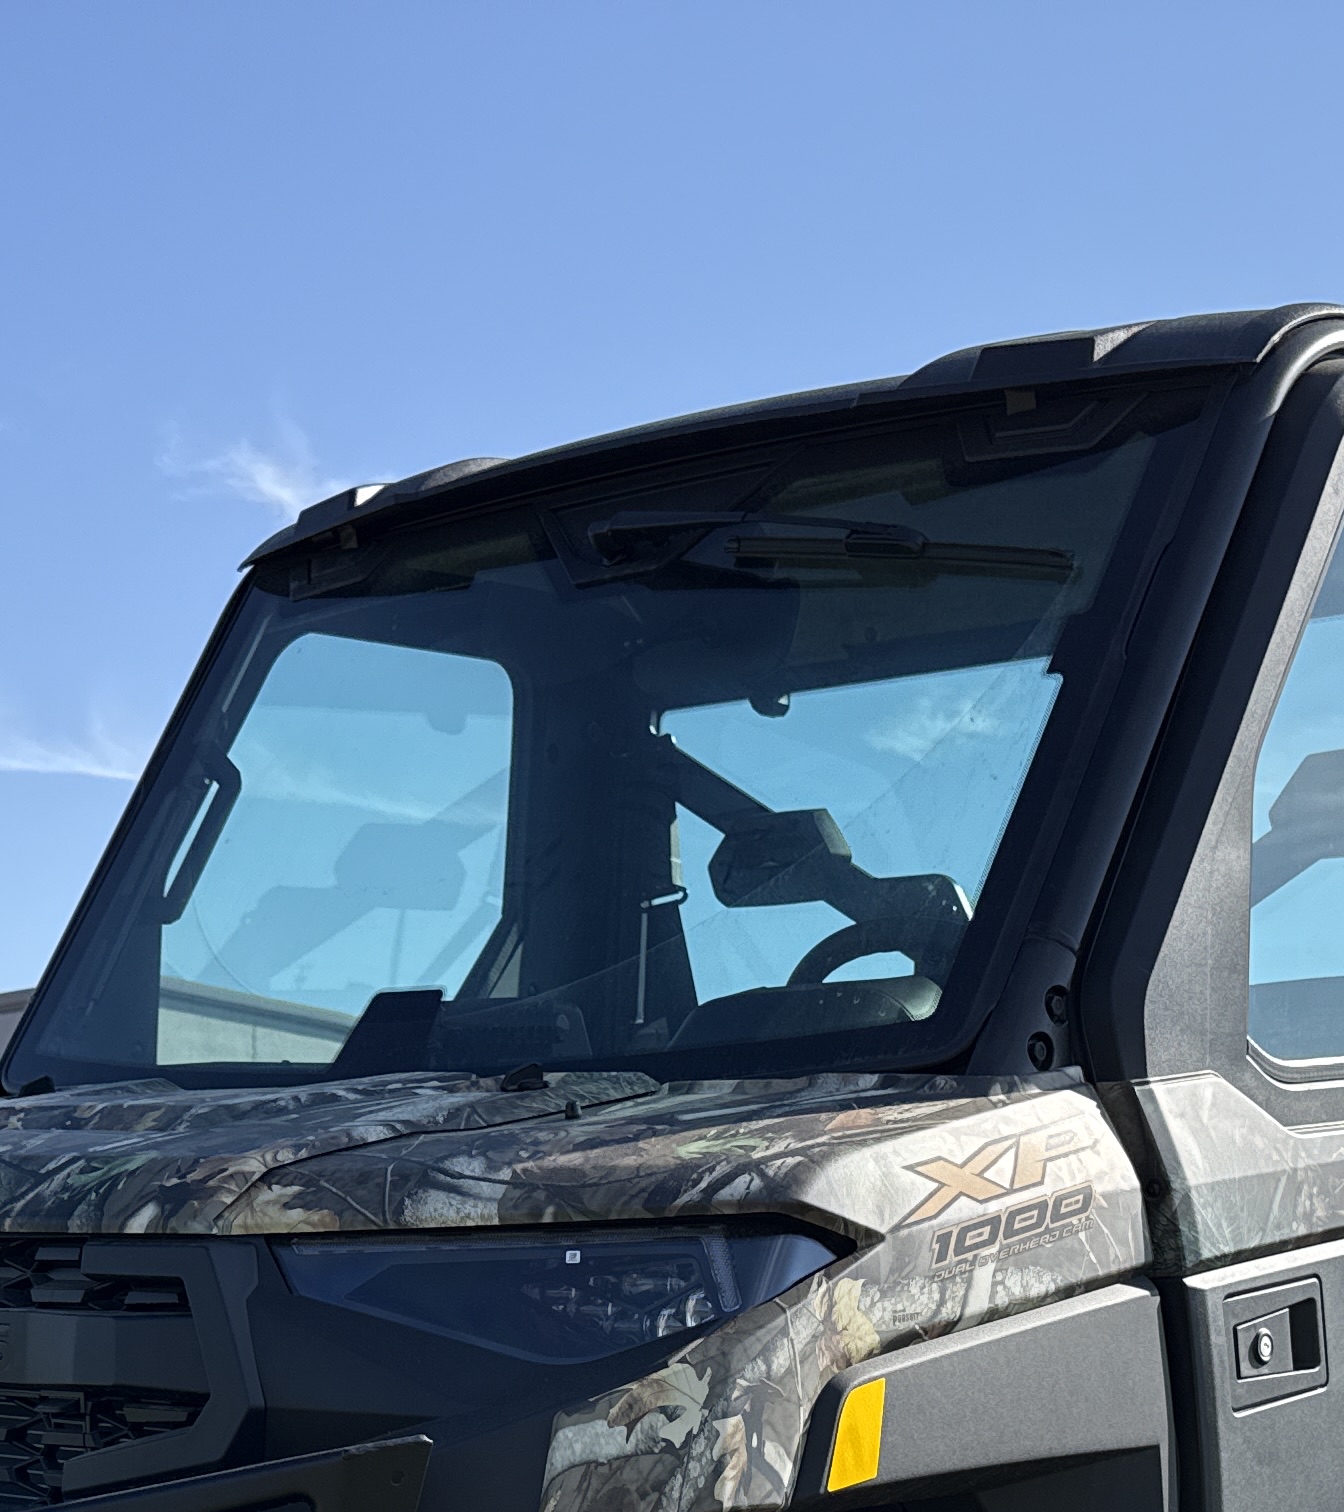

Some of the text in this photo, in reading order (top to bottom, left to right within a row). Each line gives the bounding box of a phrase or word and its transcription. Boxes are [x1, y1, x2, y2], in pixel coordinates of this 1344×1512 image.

[886, 1113, 1100, 1234] XP
[930, 1181, 1094, 1269] 1000
[933, 1219, 1094, 1282] DUAL OVERHEAD CAM
